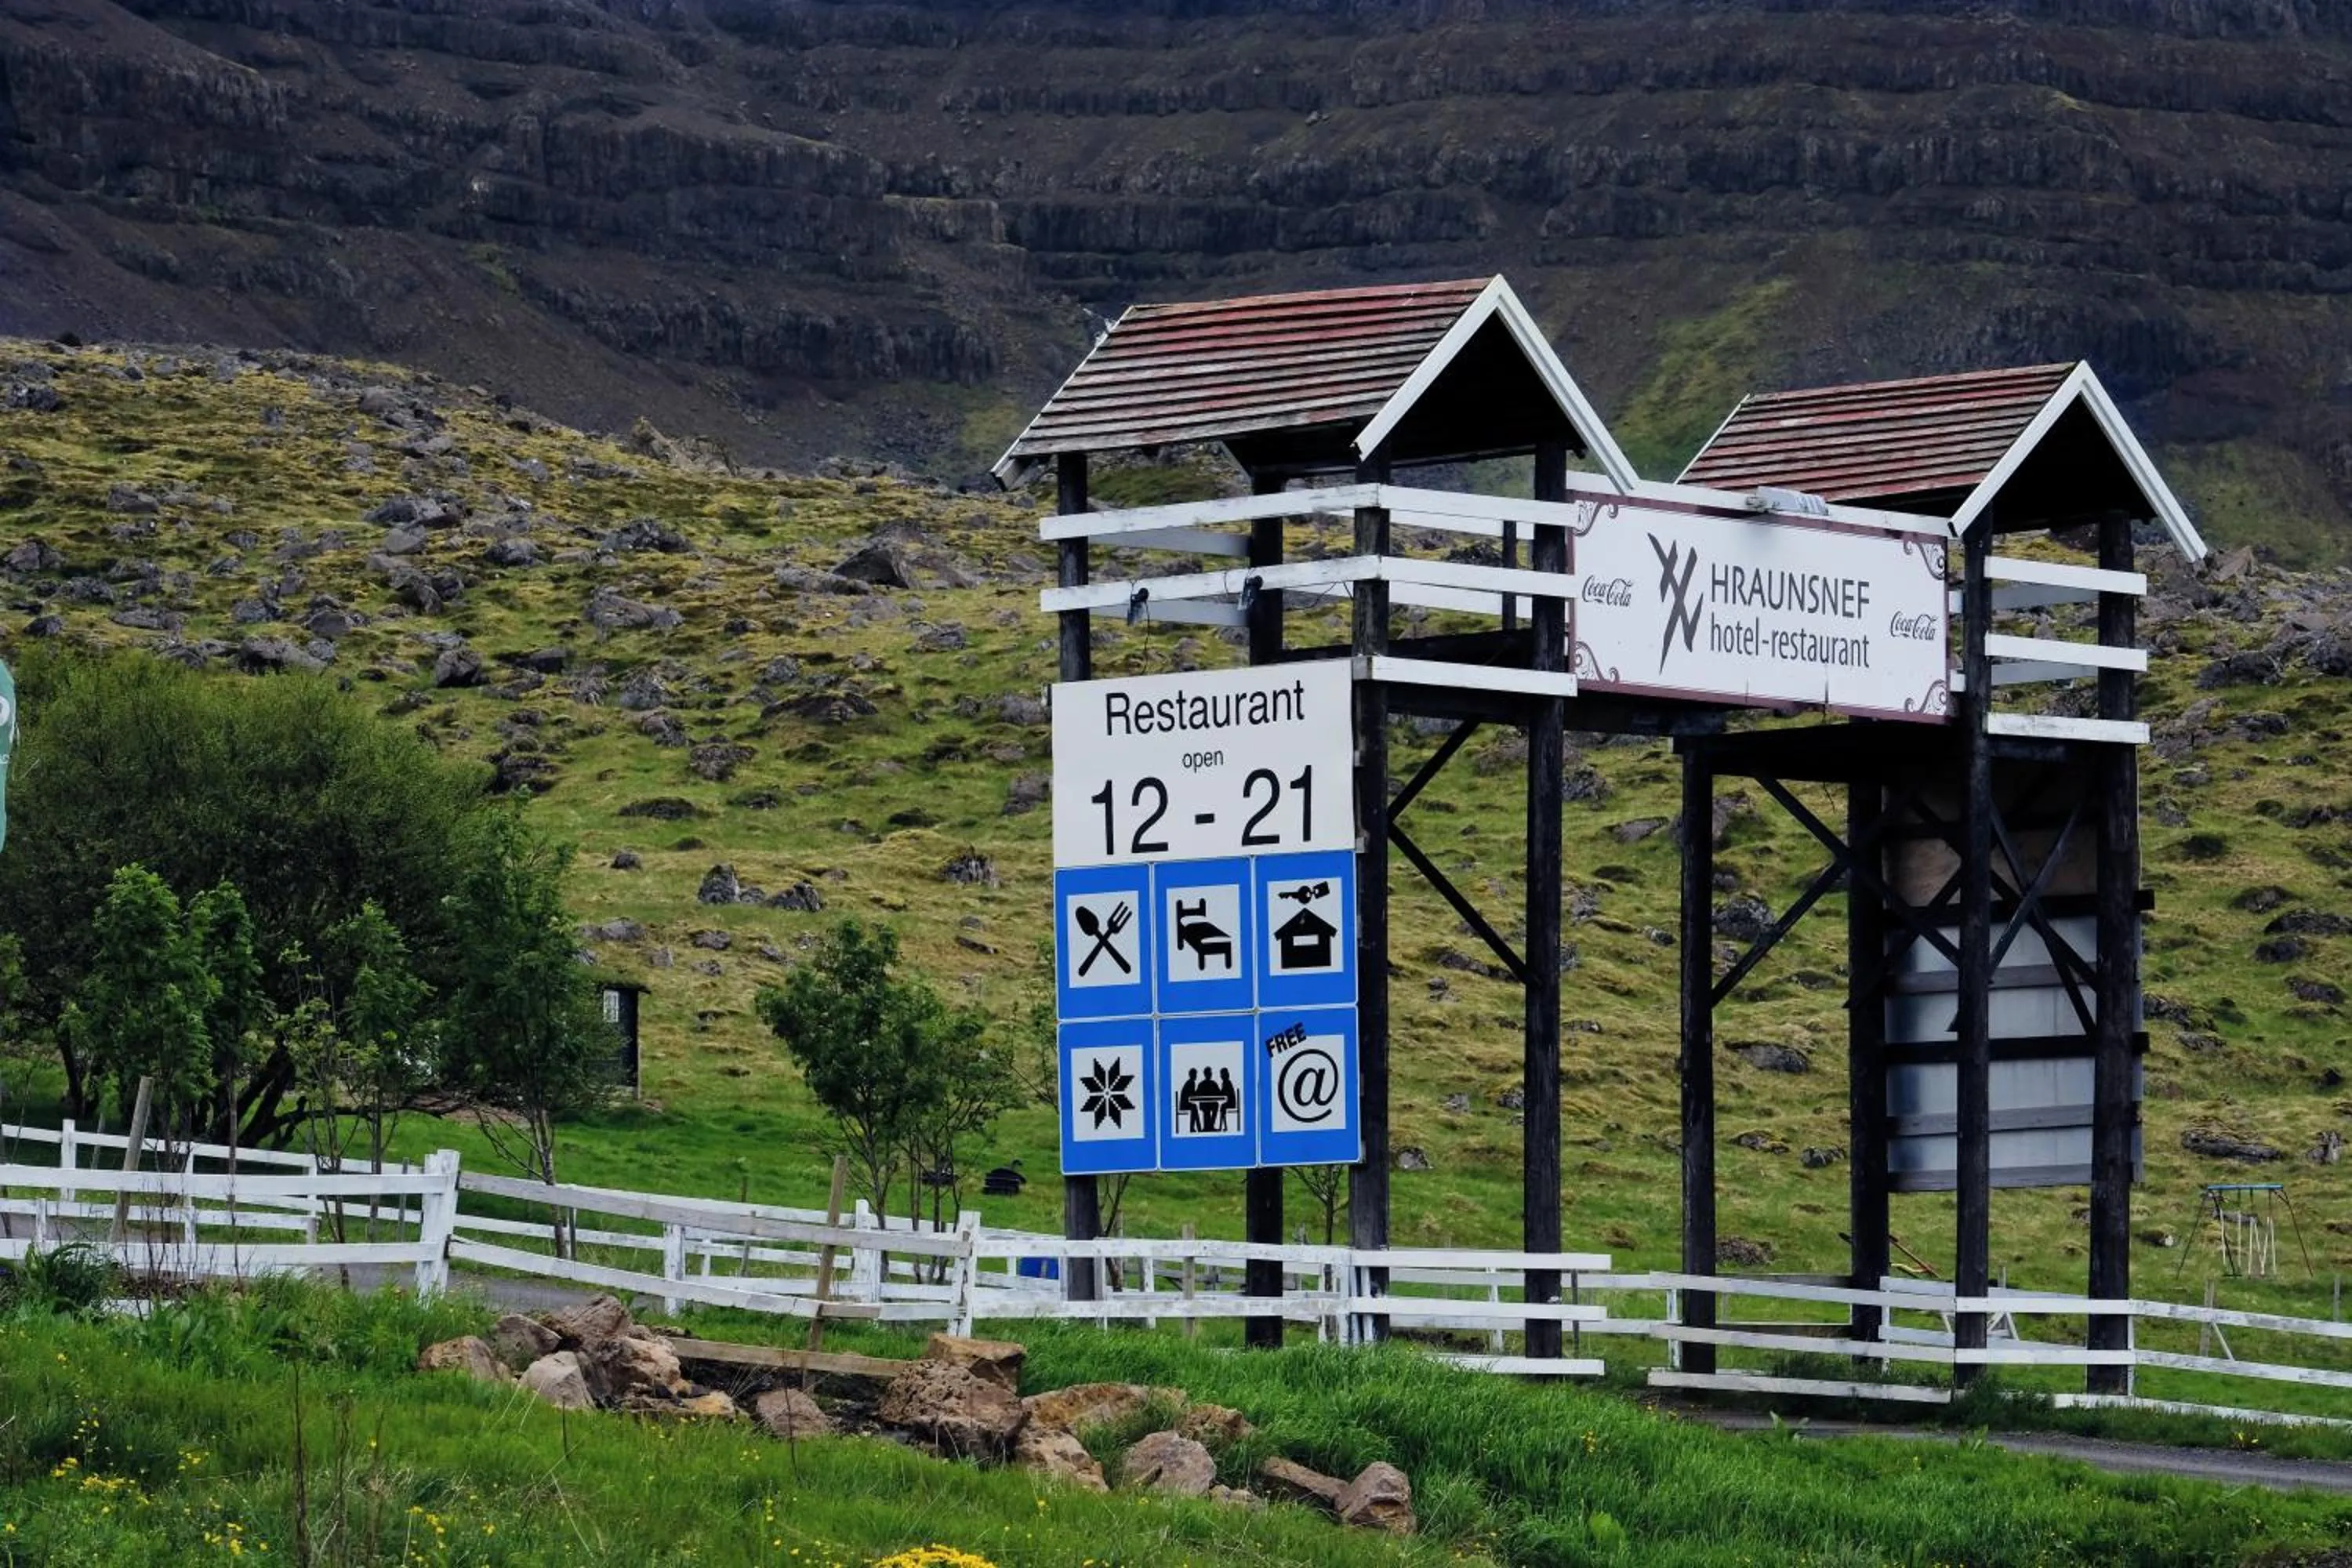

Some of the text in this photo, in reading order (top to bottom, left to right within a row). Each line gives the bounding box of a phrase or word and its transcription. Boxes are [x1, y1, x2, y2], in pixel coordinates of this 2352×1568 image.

[1711, 563, 1870, 619] HRAUNSNEF
[1710, 612, 1870, 668] hotel-restaurant
[1105, 680, 1305, 735] Restaurant
[1182, 750, 1224, 773] open
[1091, 776, 1169, 855] 12
[1241, 764, 1312, 847] 21
[1265, 1022, 1307, 1058] FREE
